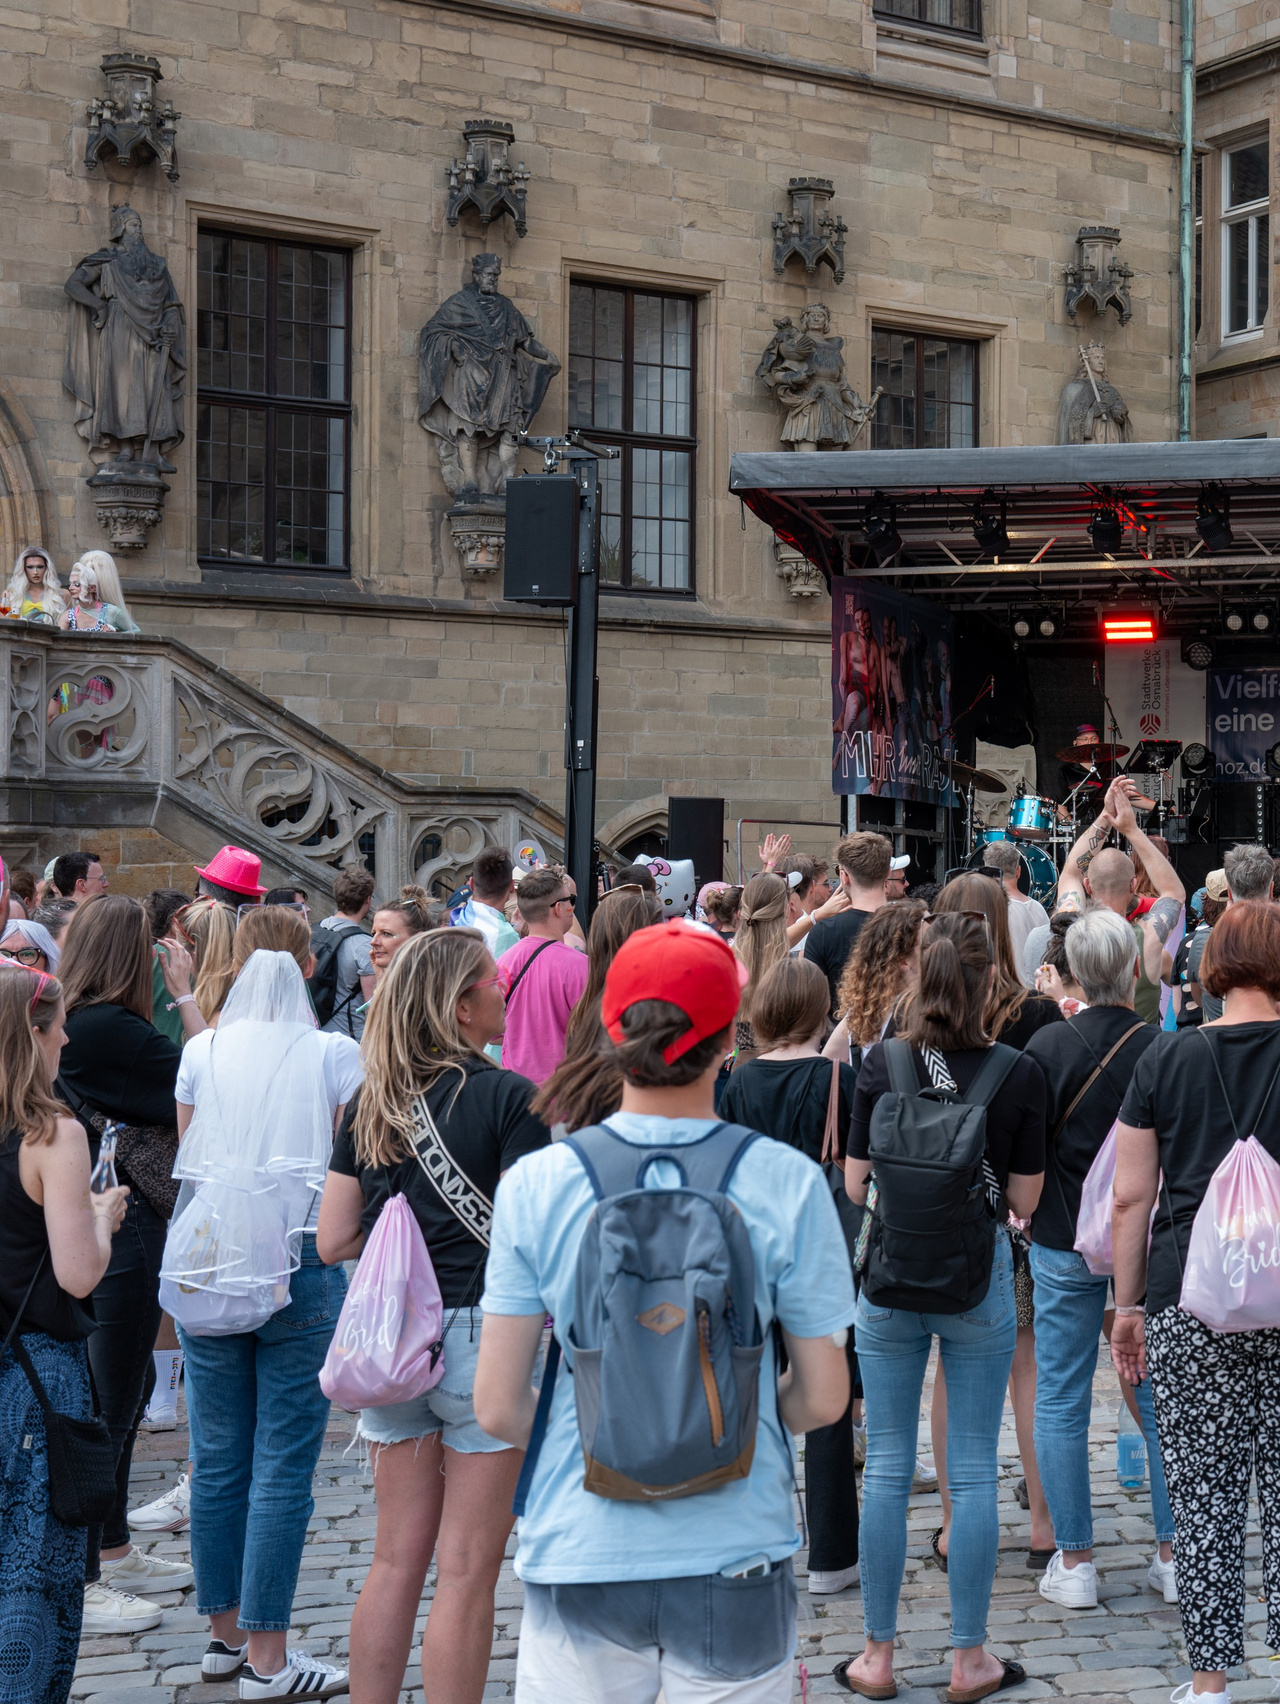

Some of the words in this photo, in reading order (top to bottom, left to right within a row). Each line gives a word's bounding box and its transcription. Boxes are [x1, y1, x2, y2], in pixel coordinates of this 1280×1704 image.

[1141, 648, 1151, 710] Stadtwerke
[1151, 649, 1161, 710] Osnabrück
[1214, 707, 1280, 733] eine
